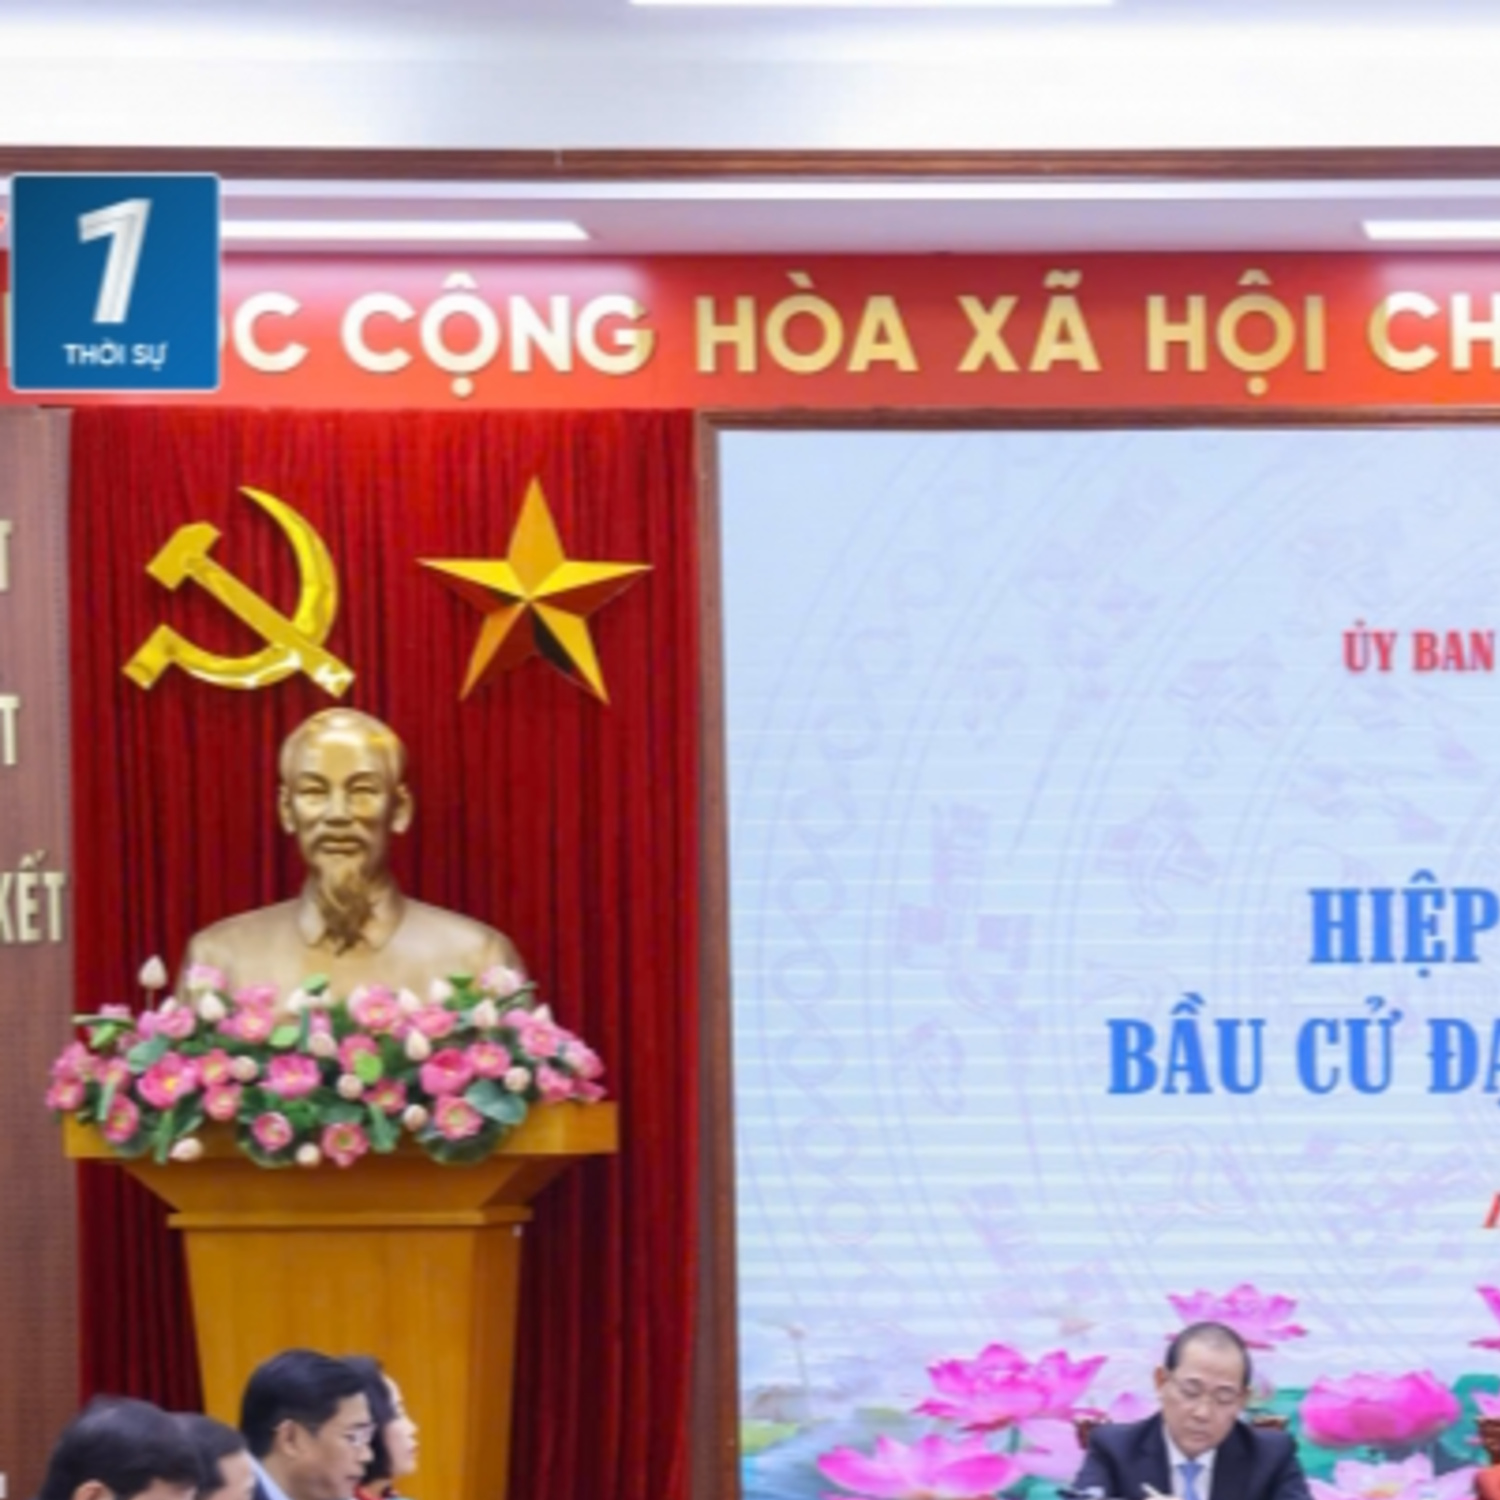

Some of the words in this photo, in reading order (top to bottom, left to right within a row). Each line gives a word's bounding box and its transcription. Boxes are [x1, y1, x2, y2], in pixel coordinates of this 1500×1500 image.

[342, 271, 655, 398] CỘNG
[696, 271, 919, 373] HÒA
[956, 268, 1102, 372] XÃ
[1146, 268, 1326, 397] HỘI
[1342, 619, 1398, 674] ỦY
[1411, 629, 1495, 673] BAN
[1105, 991, 1266, 1096] BẦU
[1295, 995, 1404, 1096] CỬ
